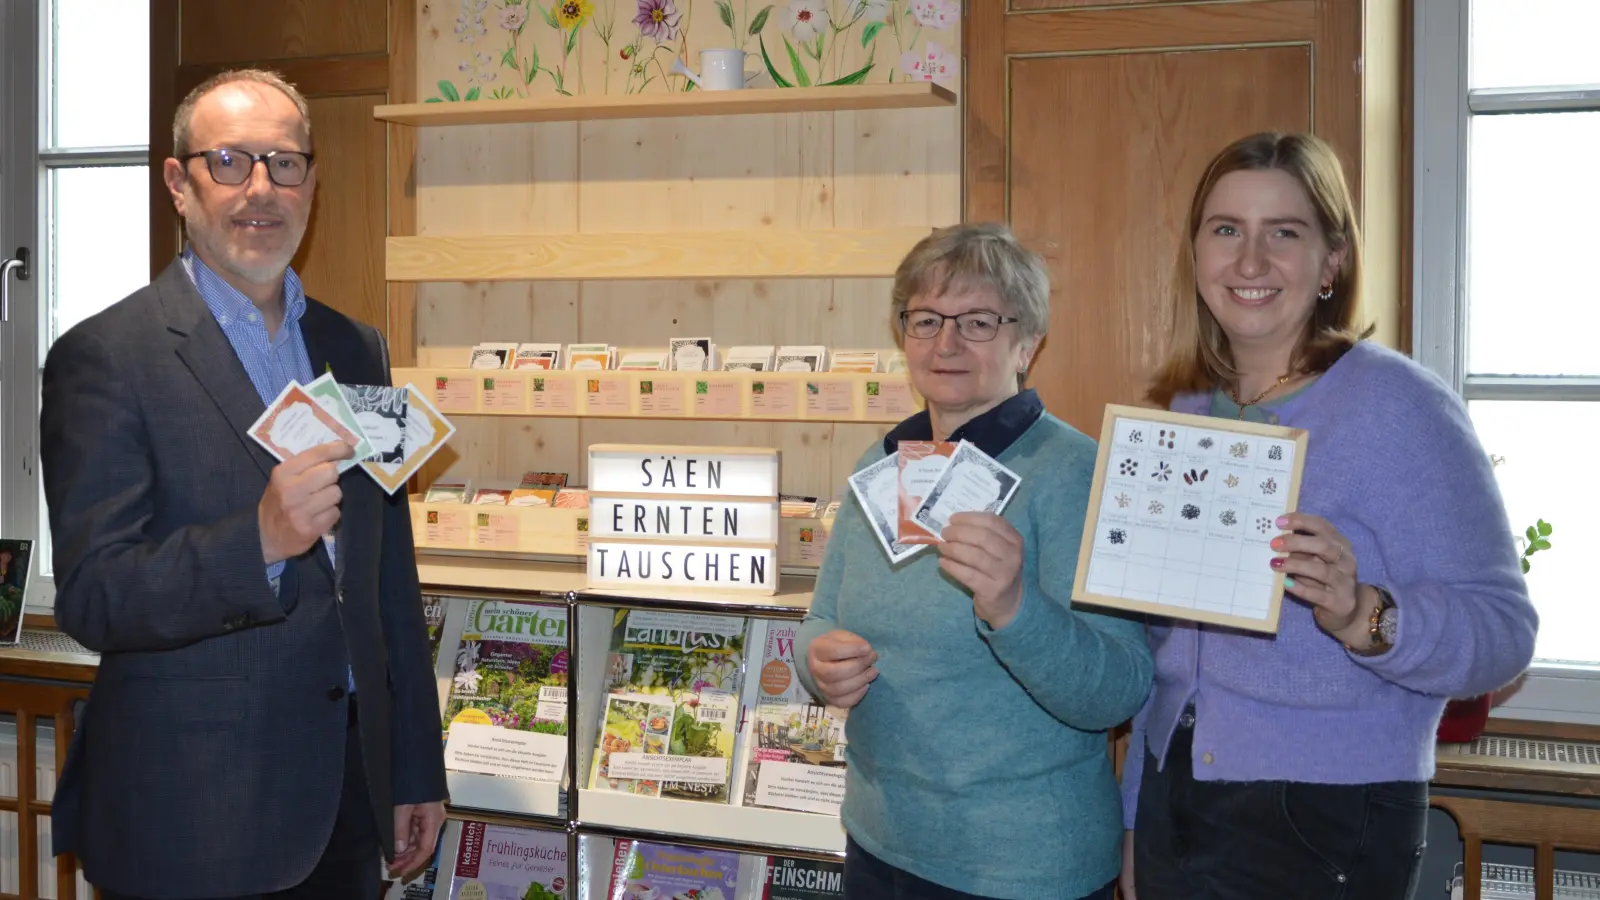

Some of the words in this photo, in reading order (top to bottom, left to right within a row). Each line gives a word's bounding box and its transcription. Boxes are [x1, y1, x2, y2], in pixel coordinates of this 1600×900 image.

[641, 455, 722, 489] SÄEN
[613, 504, 738, 536] ERNTEN
[597, 549, 765, 584] TAUSCHEN
[424, 604, 442, 618] en
[502, 608, 534, 616] schöner
[776, 638, 794, 658] W
[462, 822, 476, 866] köstlich
[486, 840, 567, 862] Frühlingsküche
[489, 859, 509, 868] Feines
[765, 866, 844, 892] FEINSCHM
